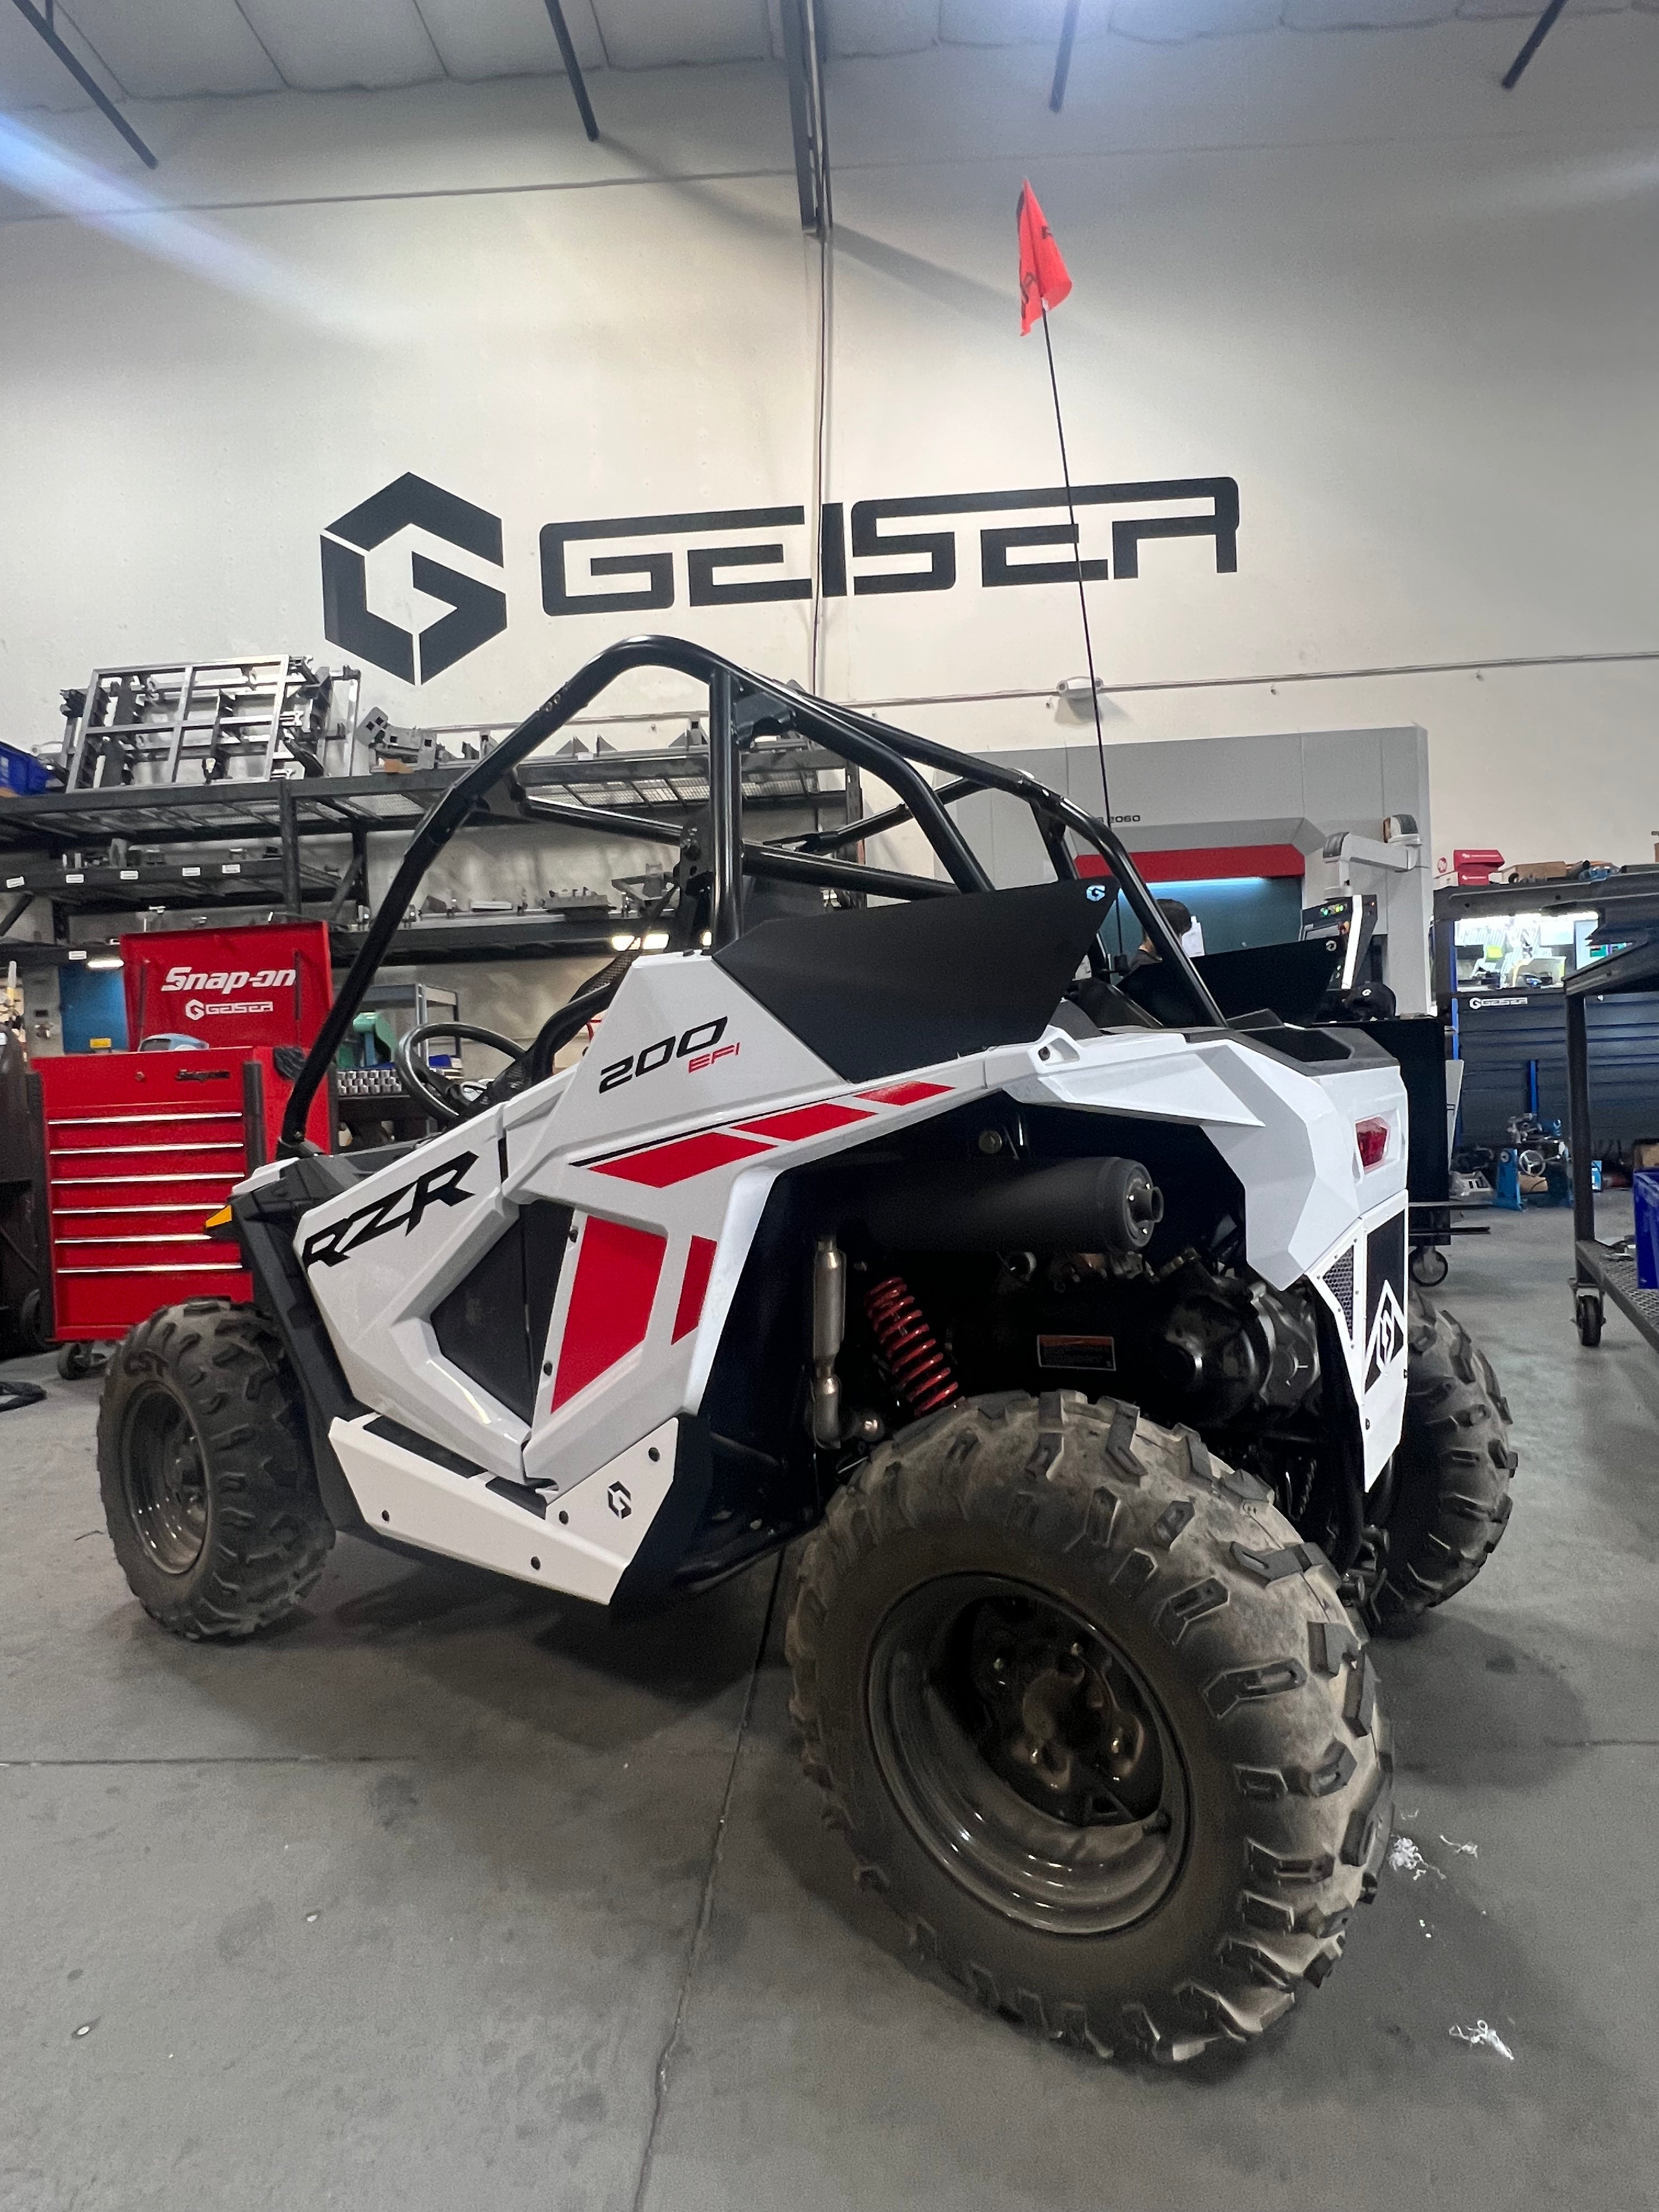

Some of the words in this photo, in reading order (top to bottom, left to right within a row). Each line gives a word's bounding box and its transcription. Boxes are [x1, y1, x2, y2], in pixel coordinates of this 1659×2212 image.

[539, 476, 1240, 617] GEISER
[161, 966, 296, 995] Snap-on
[205, 1001, 274, 1015] GEISER
[599, 1015, 728, 1094] 200
[689, 1042, 741, 1074] EFI
[302, 1150, 479, 1268] RZR
